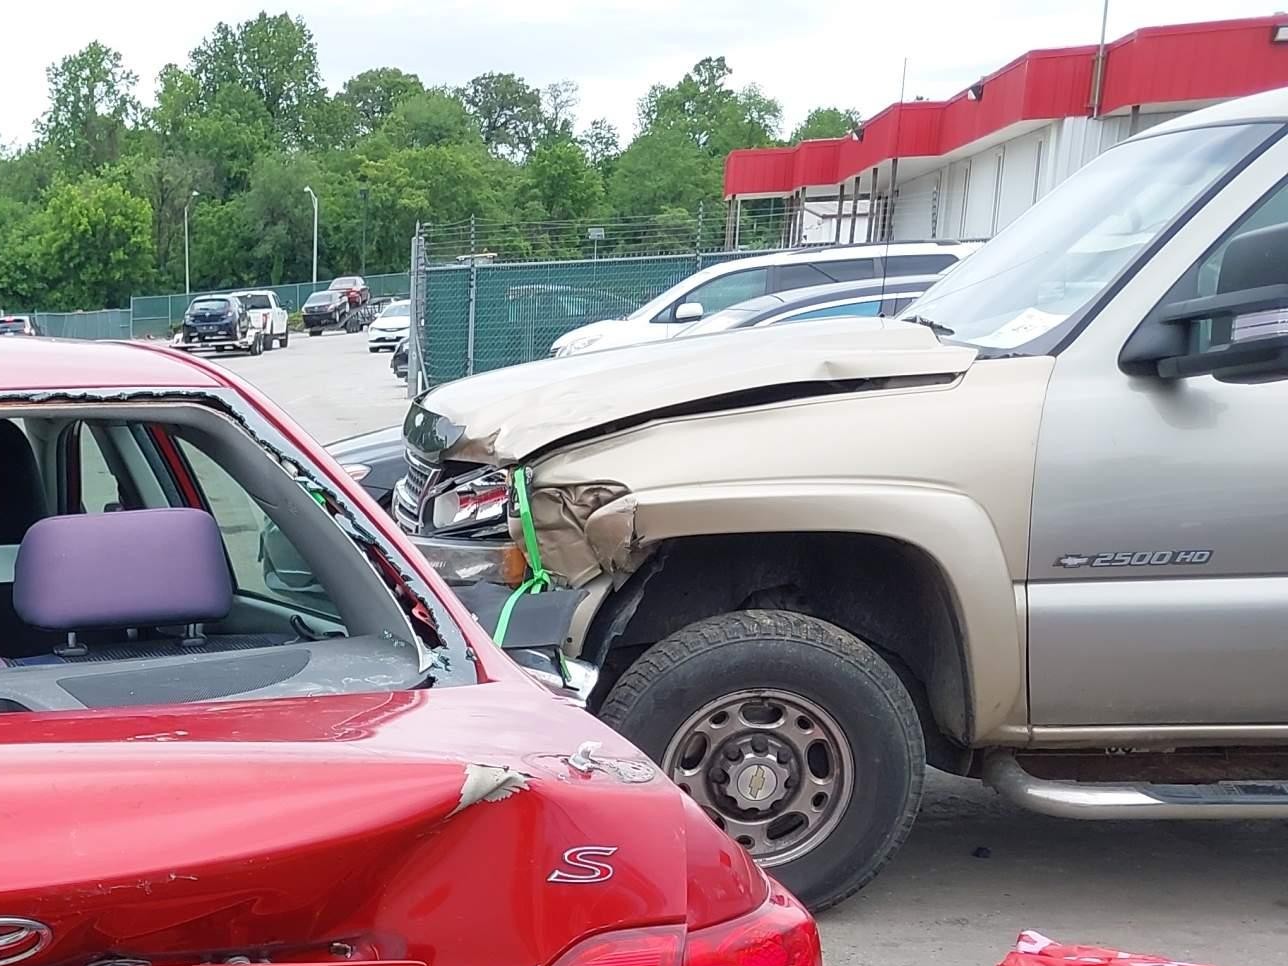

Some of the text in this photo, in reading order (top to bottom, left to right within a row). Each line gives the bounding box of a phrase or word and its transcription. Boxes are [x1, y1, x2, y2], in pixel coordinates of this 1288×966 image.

[1092, 551, 1211, 567] 2500 HD
[546, 845, 618, 883] S
